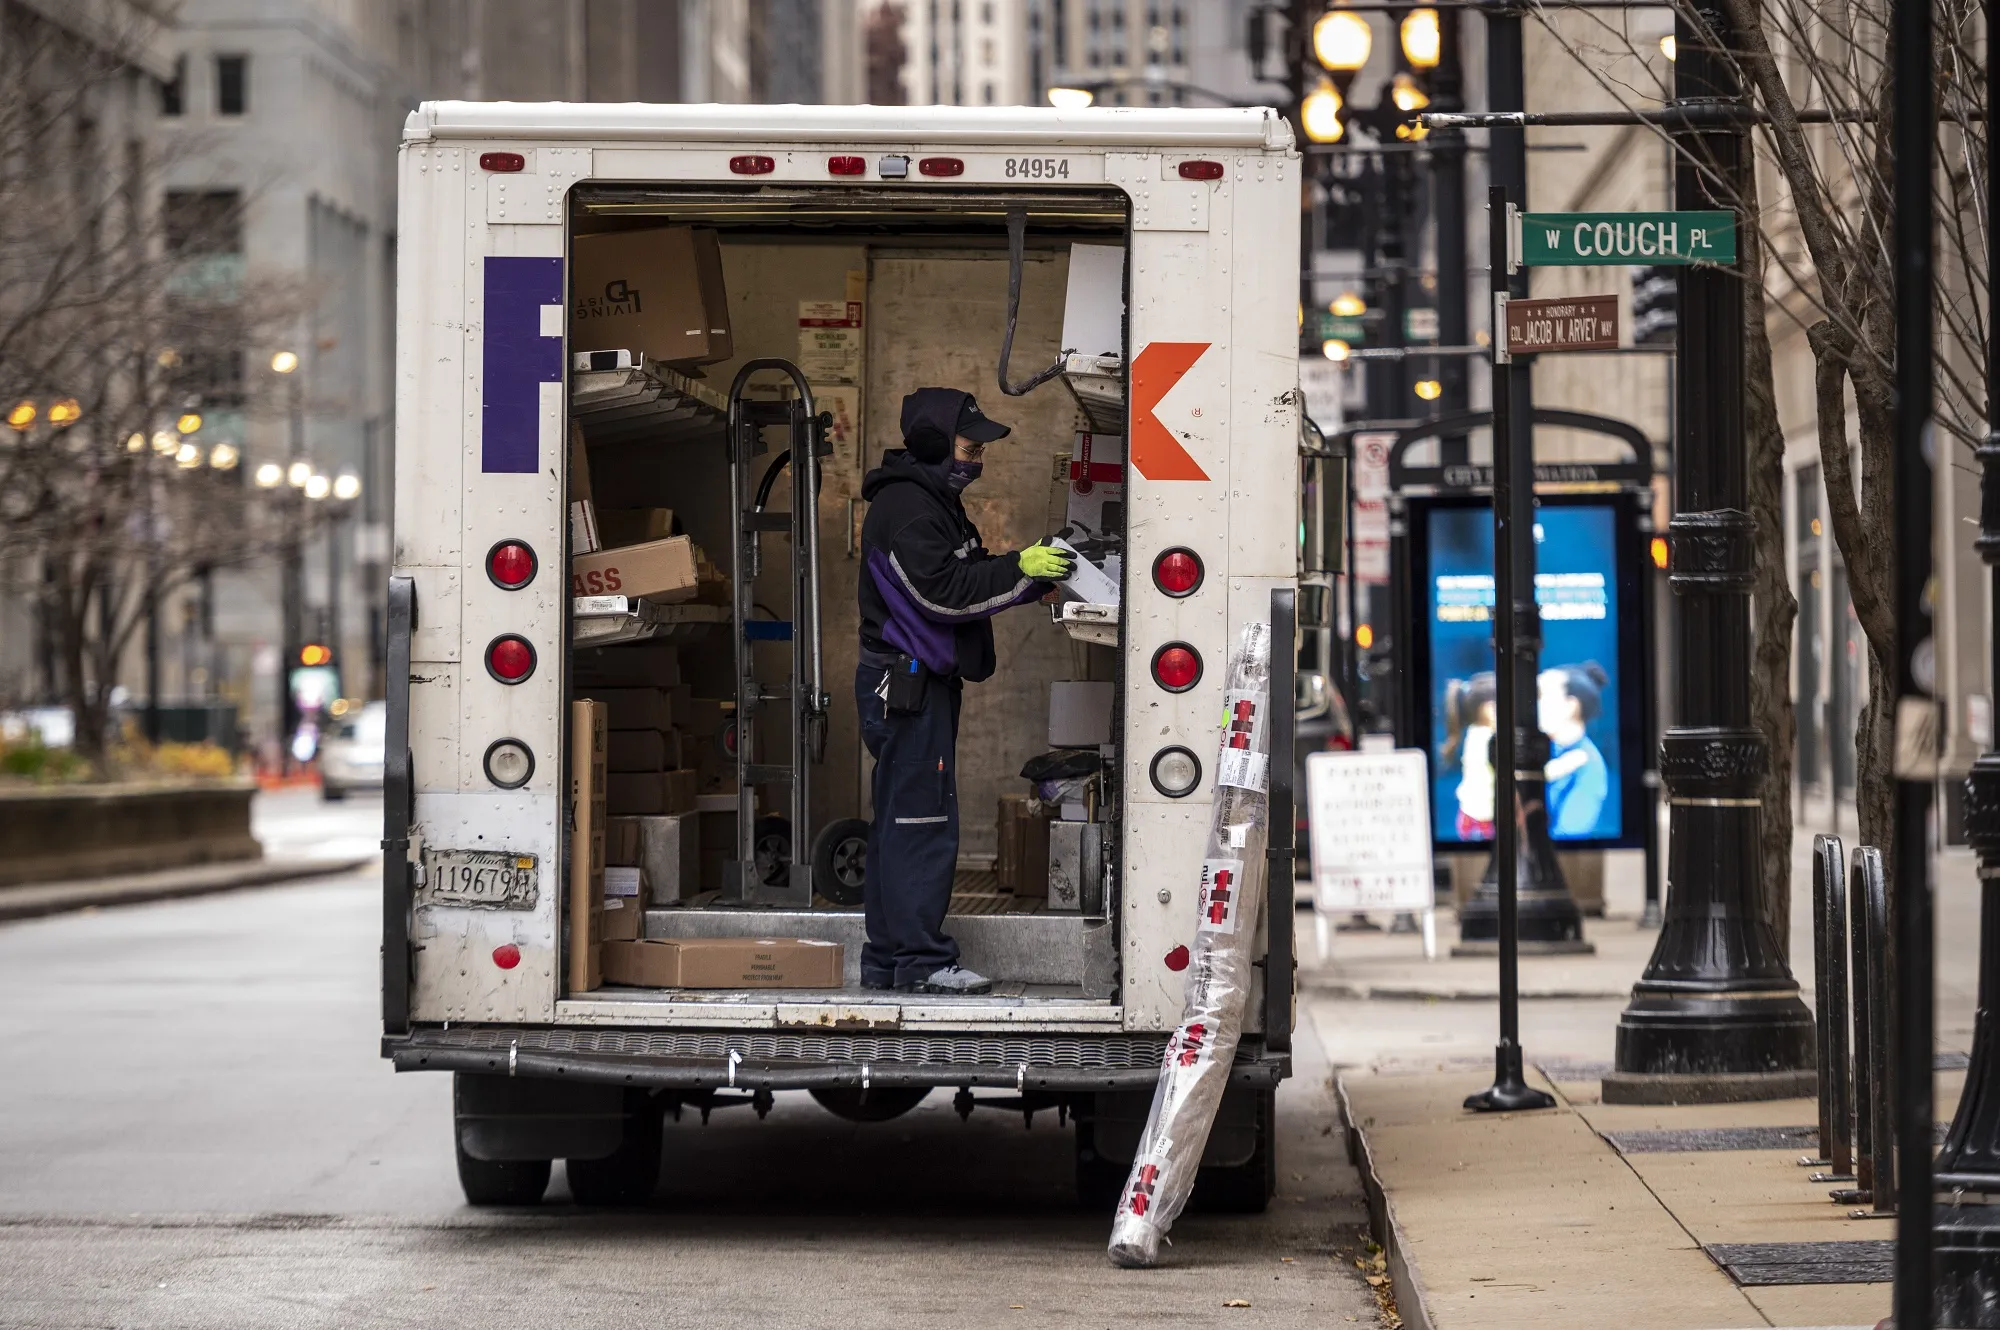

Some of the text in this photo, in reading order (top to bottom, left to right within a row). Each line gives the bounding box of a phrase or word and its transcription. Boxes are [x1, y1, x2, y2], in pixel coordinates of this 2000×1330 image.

[1005, 158, 1070, 179] 84954
[1545, 222, 1713, 257] W COUCH PL
[1545, 305, 1577, 318] HONORARY
[1524, 319, 1553, 345] JACOB
[1568, 317, 1597, 343] ARVEY
[1600, 320, 1613, 337] WAY
[760, 974, 773, 982] FROM
